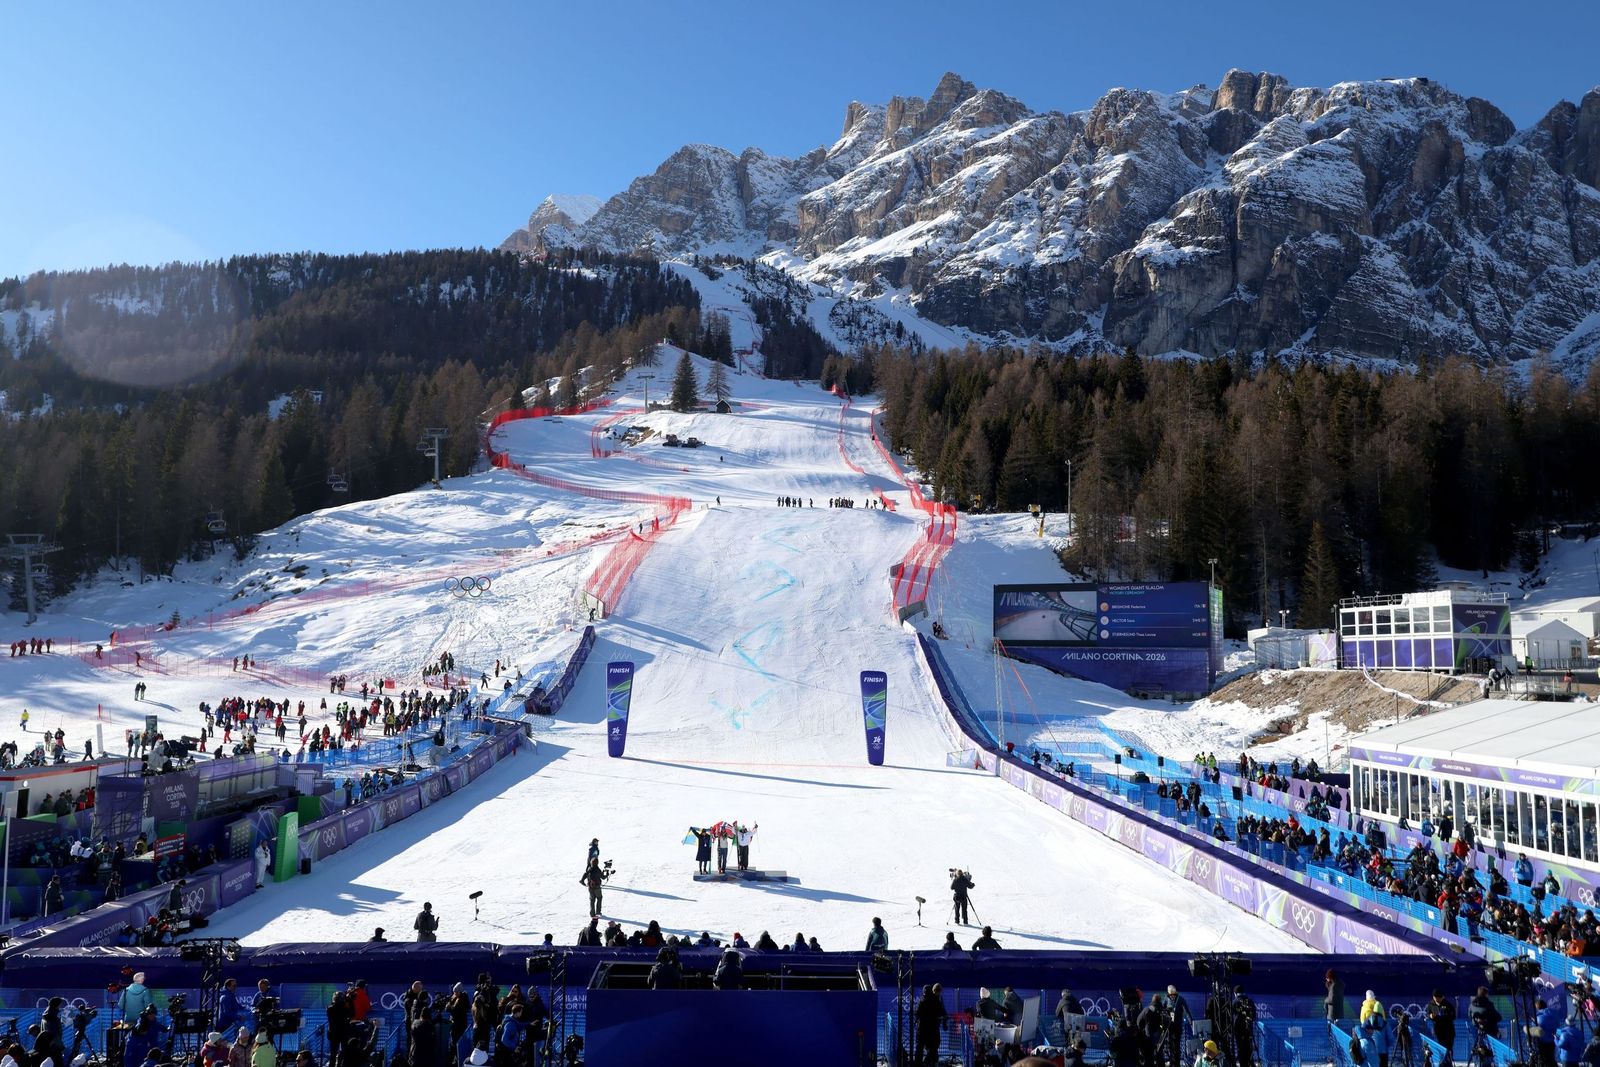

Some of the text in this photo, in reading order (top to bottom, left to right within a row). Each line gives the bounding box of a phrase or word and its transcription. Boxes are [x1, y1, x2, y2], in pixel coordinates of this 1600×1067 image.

[163, 784, 184, 794] MILANO
[79, 920, 129, 947] MILANO CORTINA
[1340, 930, 1384, 954] MILANO CORTINA
